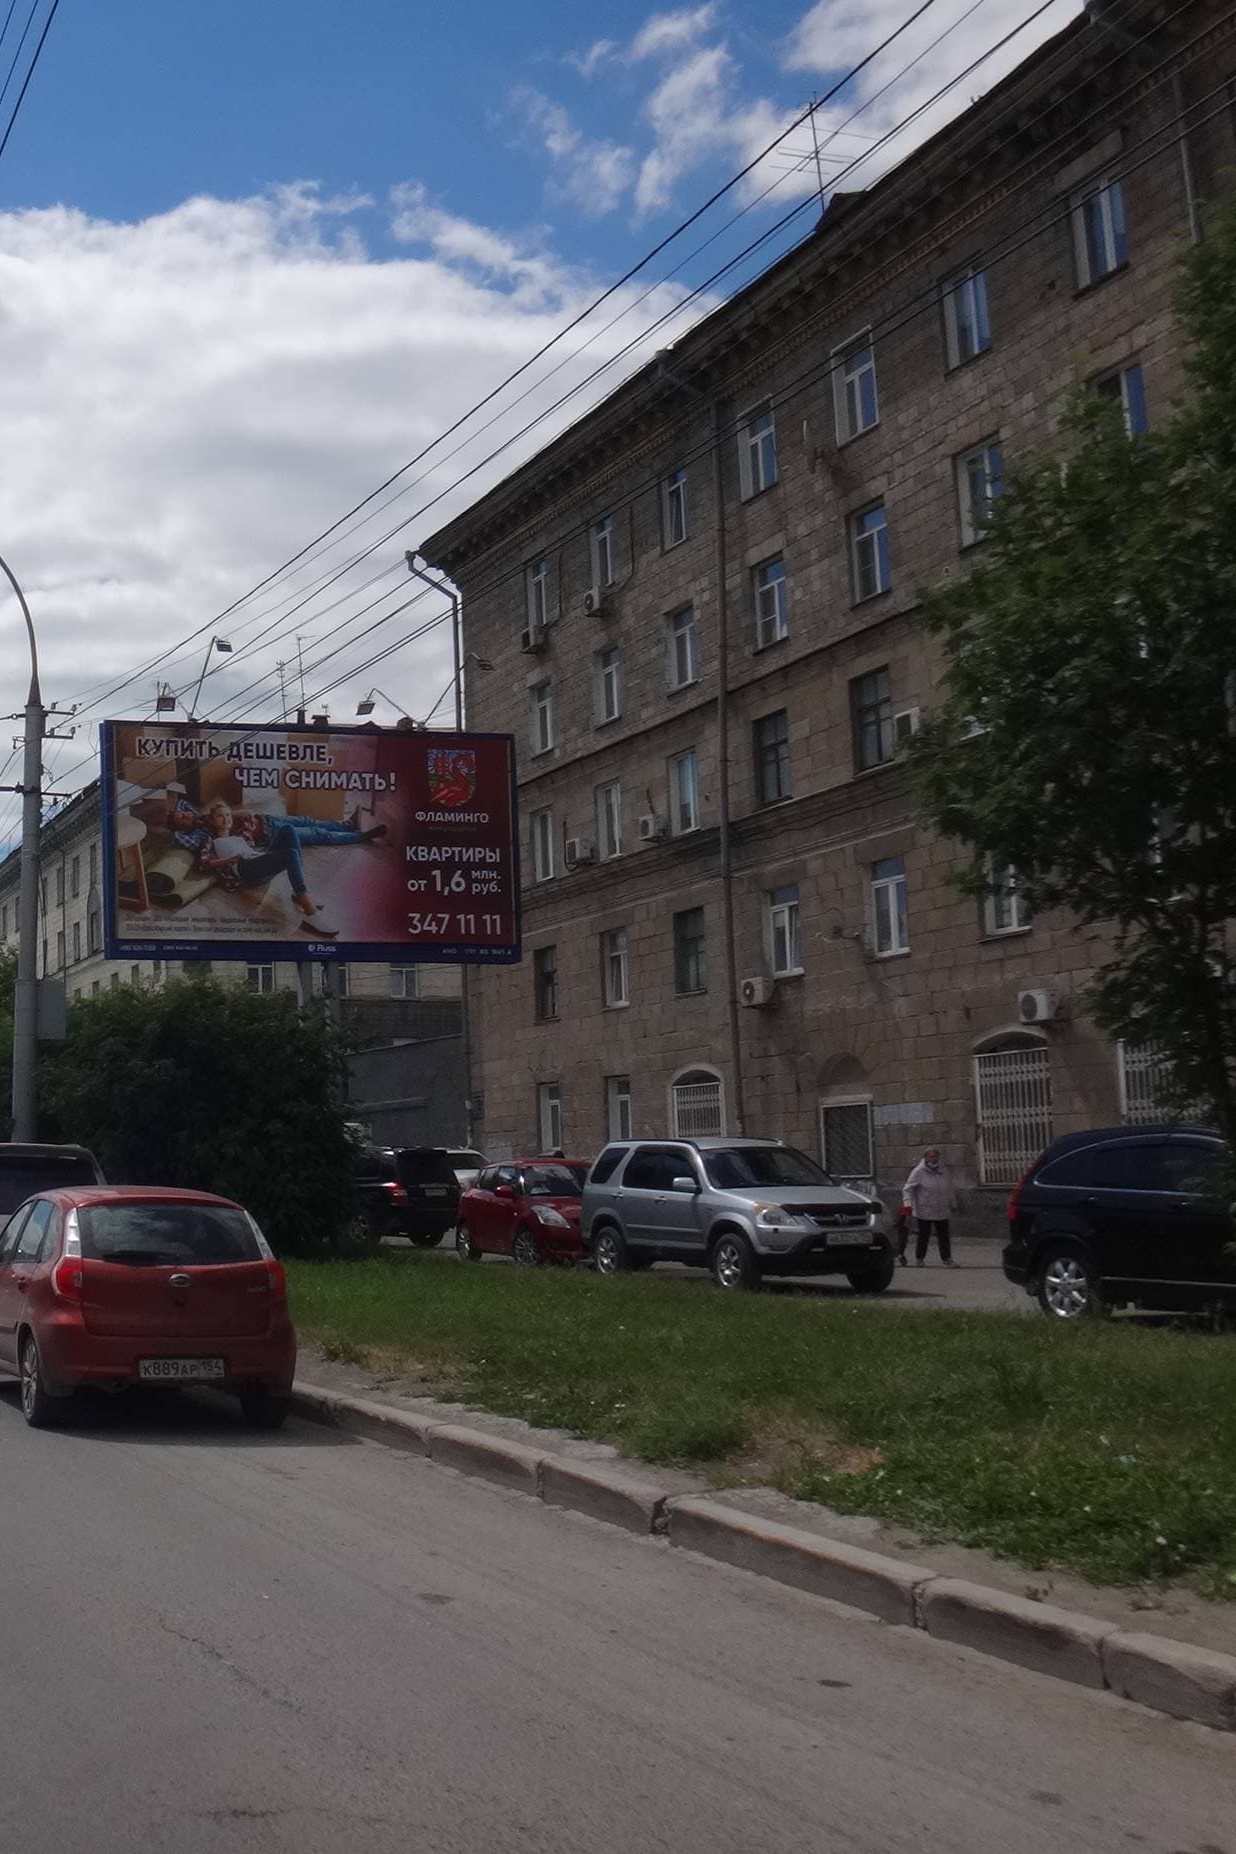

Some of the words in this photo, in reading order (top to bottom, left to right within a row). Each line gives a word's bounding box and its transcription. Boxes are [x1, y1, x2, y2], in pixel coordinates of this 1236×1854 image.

[136, 736, 219, 759] КУПИТЬ
[226, 742, 333, 765] ДЕШЕВЛЕ,
[234, 767, 280, 789] ЧЕМ
[284, 769, 397, 792] СНИМАТЬ!
[414, 810, 490, 824] ФЛАМИНГО
[406, 846, 501, 863] КВАРТИРЫ
[407, 879, 427, 892] от
[431, 869, 466, 896] 1,6
[471, 881, 502, 895] руб.
[407, 912, 450, 934] 347
[456, 913, 476, 935] 11
[481, 914, 502, 936] 11
